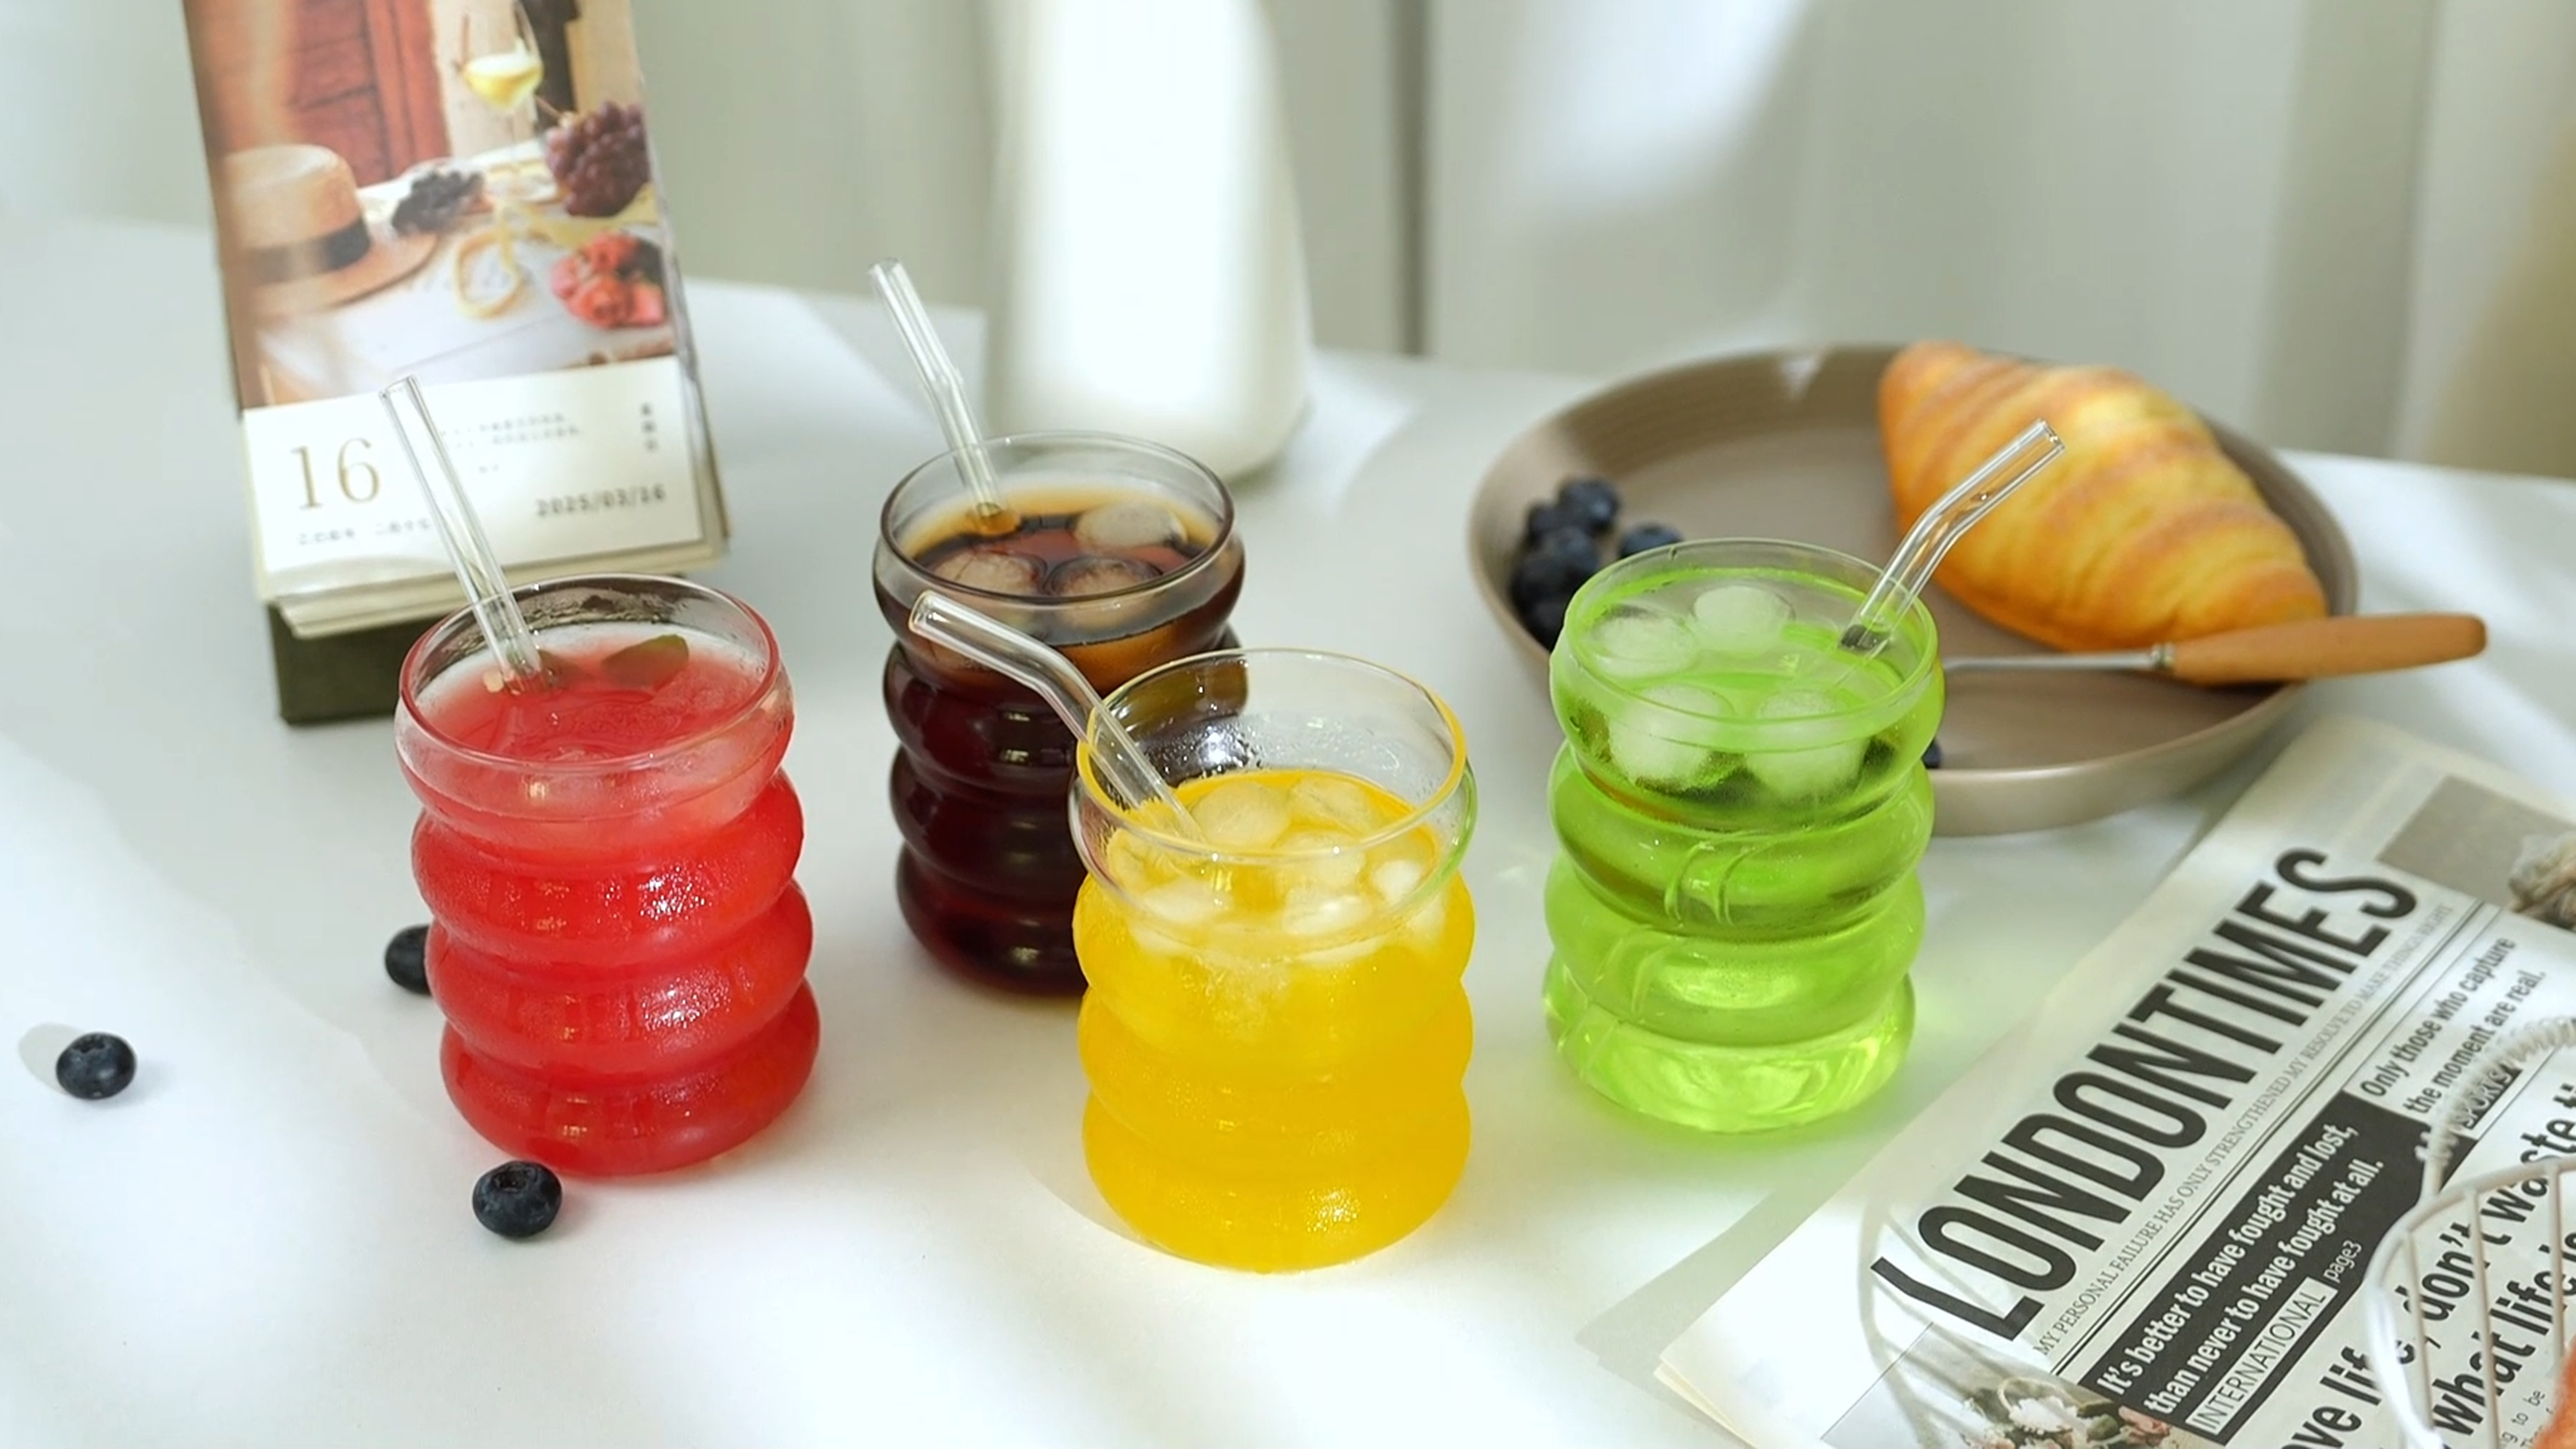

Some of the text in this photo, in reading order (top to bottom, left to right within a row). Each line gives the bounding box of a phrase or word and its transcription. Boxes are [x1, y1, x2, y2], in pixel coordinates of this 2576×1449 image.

[290, 437, 380, 510] 16
[537, 483, 666, 518] 2025/03/16
[2359, 937, 2516, 1097] Only those who capture
[2402, 970, 2546, 1114] the moment are real.
[2033, 1331, 2060, 1356] MY
[2051, 1275, 2118, 1338] PERSONAL
[2110, 1222, 2162, 1276] FAILURE
[2154, 1196, 2186, 1230] HAS
[2177, 1163, 2216, 1198] ONLY
[2205, 1070, 2293, 1167] STRENGTHENED
[2300, 1010, 2349, 1060] RESOLVE
[2344, 994, 2365, 1018] TO
[2359, 965, 2393, 1005] MAKE
[2385, 935, 2422, 973] THINGS
[2418, 905, 2455, 940] RIGHT
[2097, 1124, 2359, 1395] It's better to have fought and lost,
[2145, 1159, 2383, 1414] than never to have fought at all.
[2192, 1240, 2362, 1429] INTERNATIONAL page3
[2511, 1413, 2528, 1426] to
[2523, 1390, 2545, 1406] be
